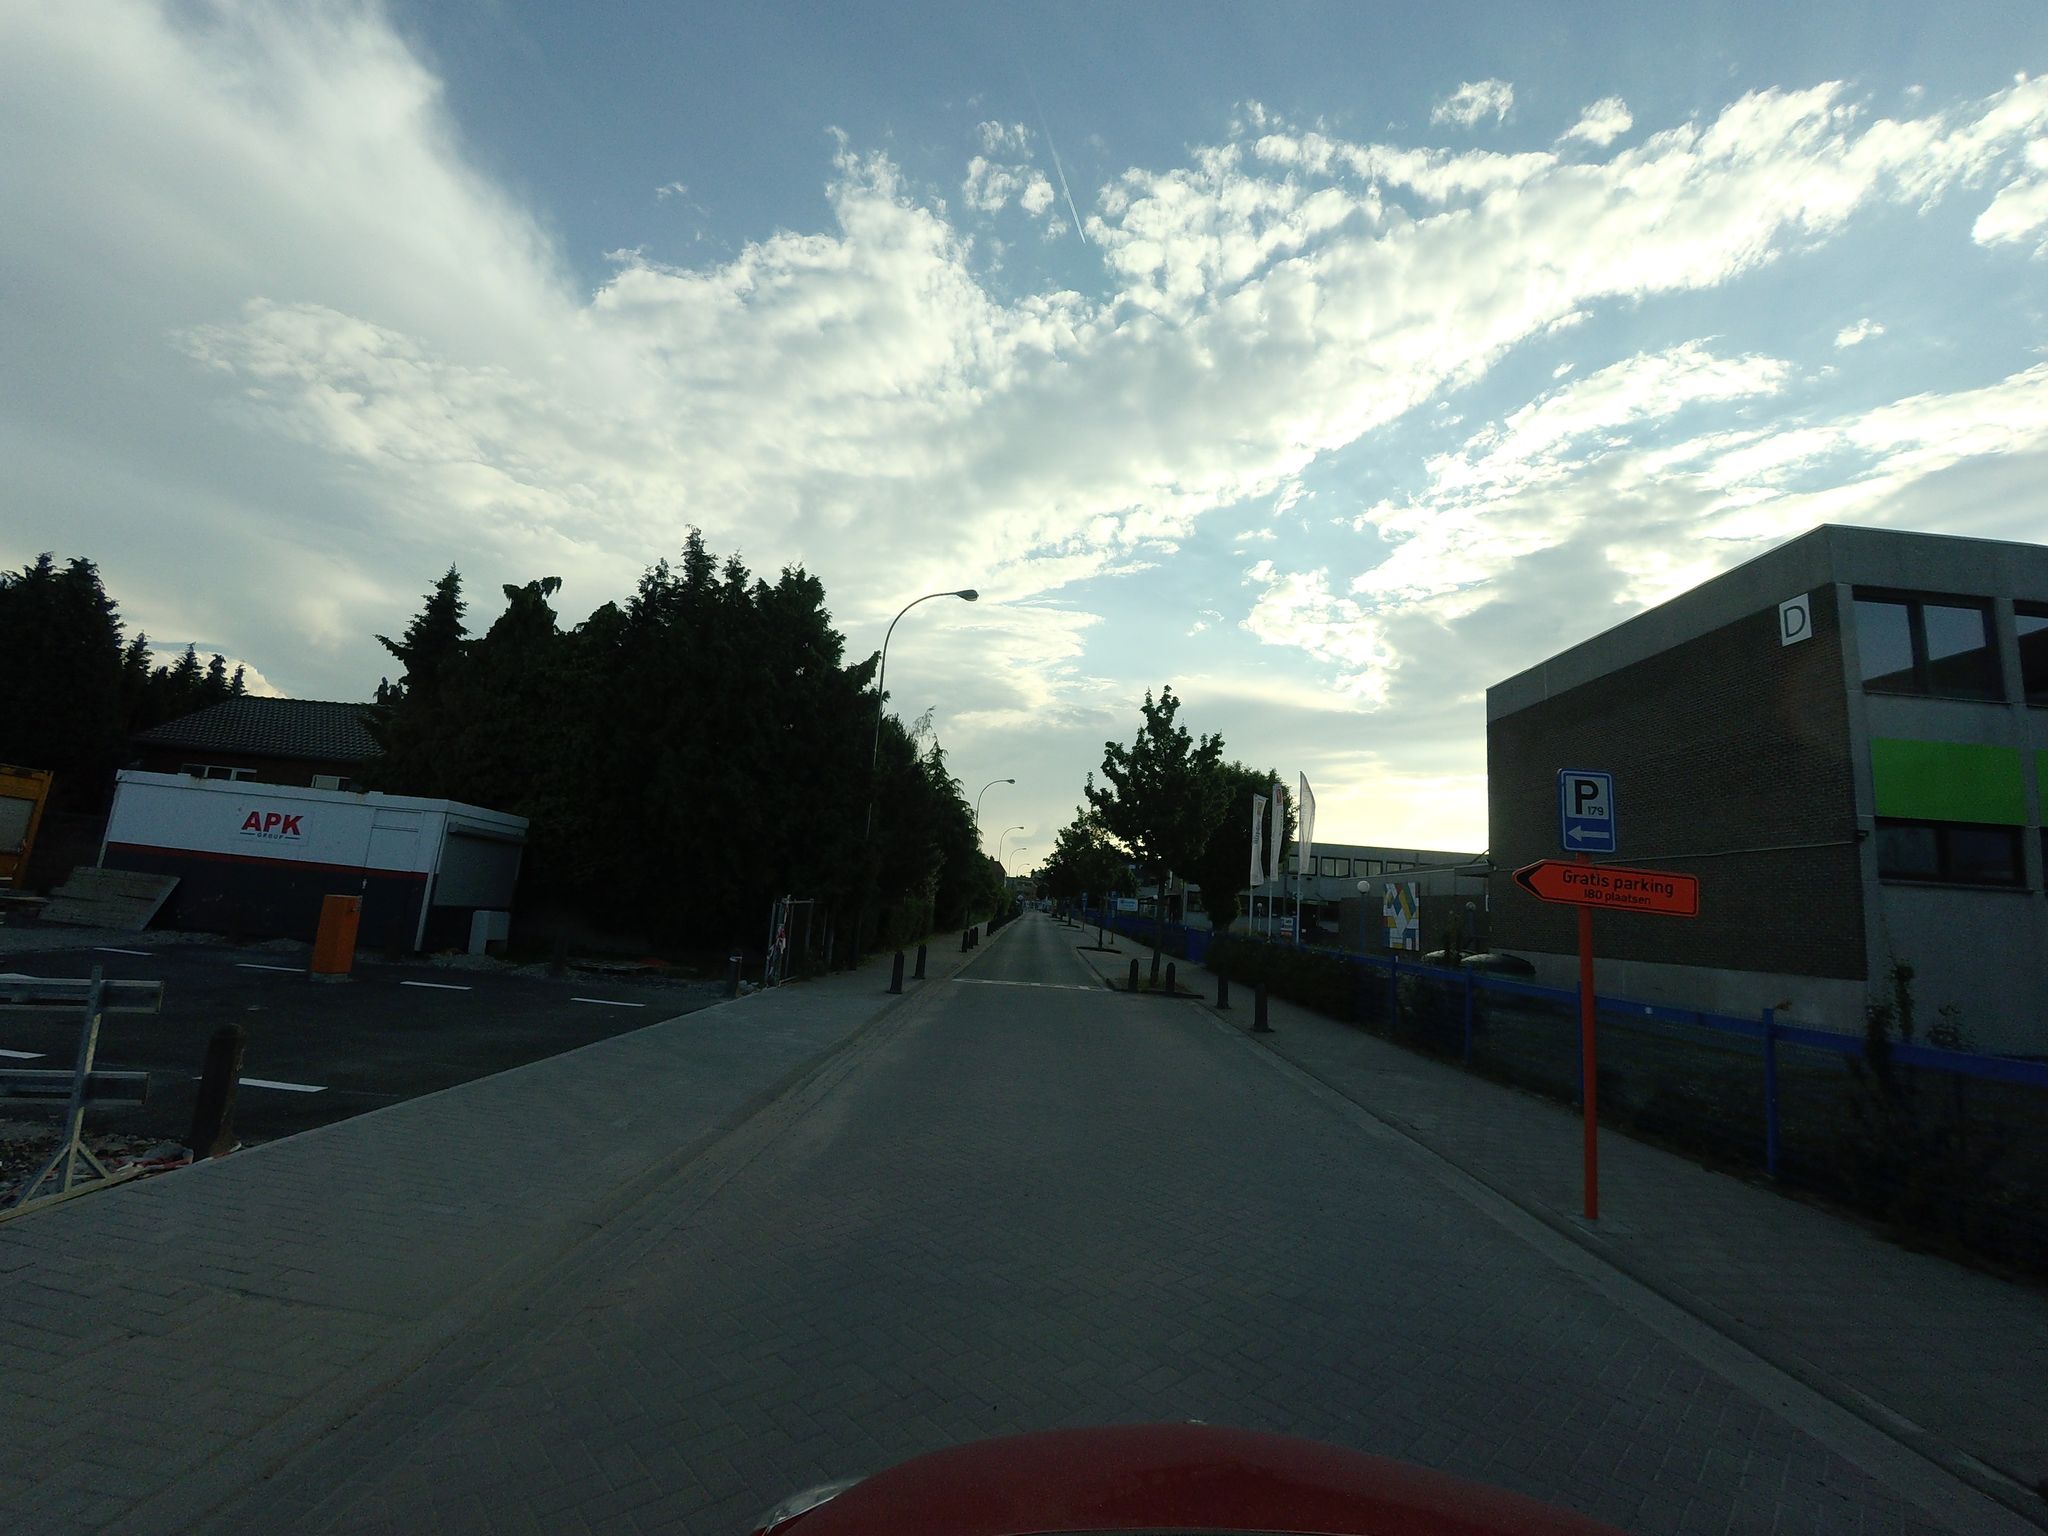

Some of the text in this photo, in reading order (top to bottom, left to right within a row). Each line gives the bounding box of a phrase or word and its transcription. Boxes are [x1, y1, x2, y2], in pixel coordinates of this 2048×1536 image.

[1784, 605, 1806, 638] D
[1575, 780, 1598, 814] P
[241, 811, 304, 836] APK
[1588, 806, 1604, 816] 179
[1562, 869, 1674, 898] Gratis parking
[1584, 888, 1651, 905] 180 plaatsen
